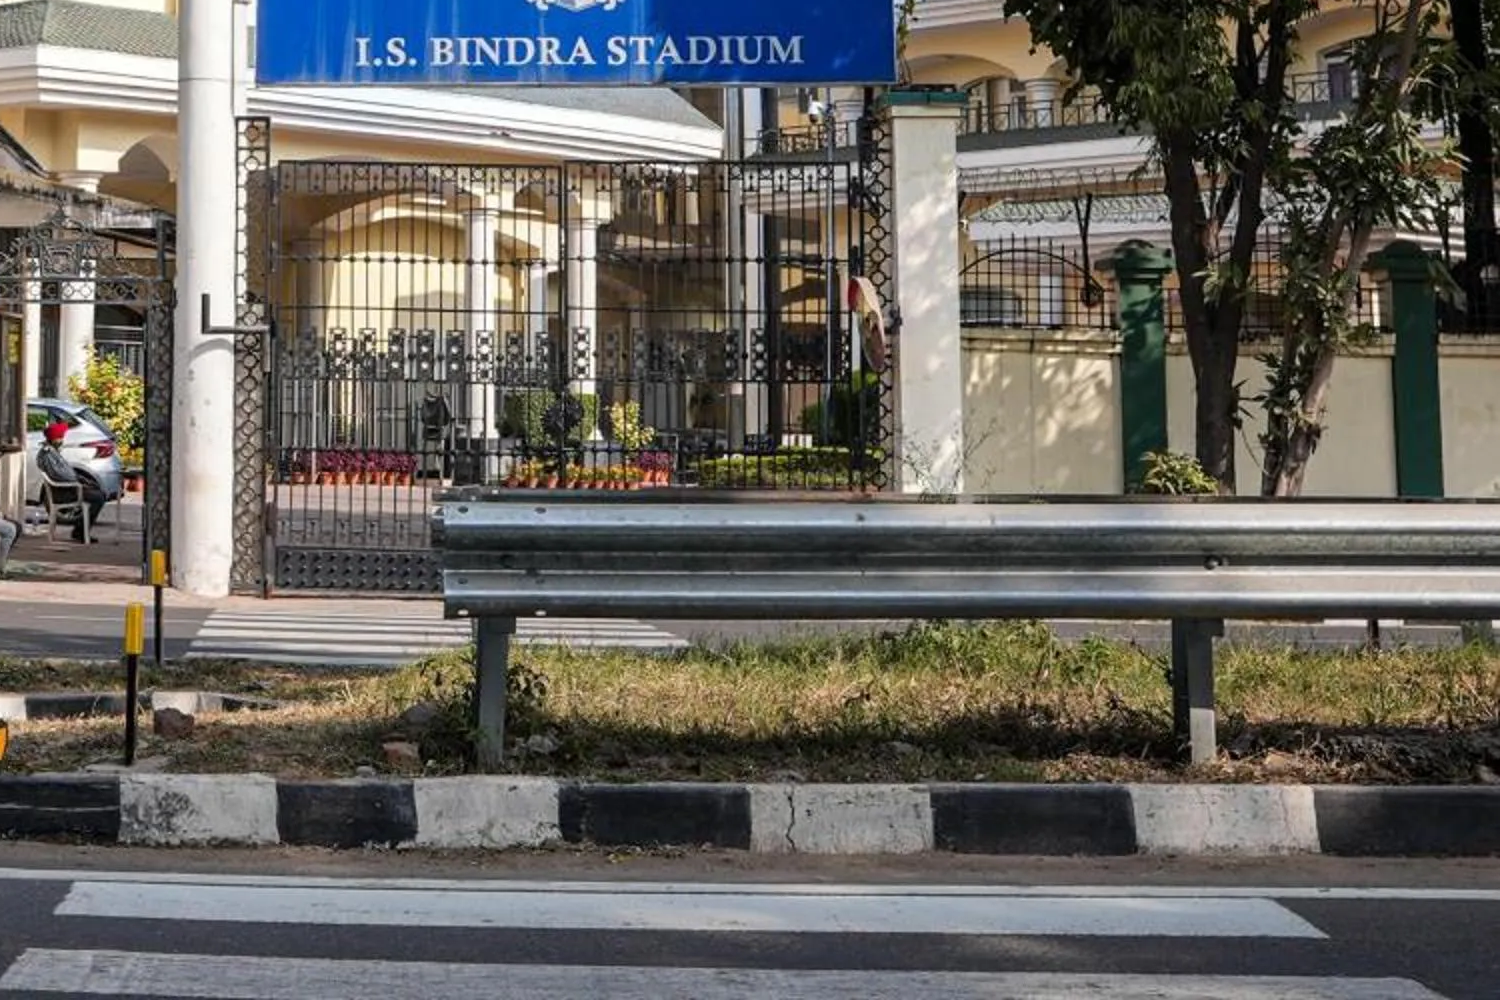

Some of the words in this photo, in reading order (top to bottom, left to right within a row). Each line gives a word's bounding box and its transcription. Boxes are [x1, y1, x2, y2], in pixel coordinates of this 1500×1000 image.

[355, 36, 417, 67] I.S.
[429, 36, 596, 66] BINDRA
[606, 34, 804, 66] STADIUM
